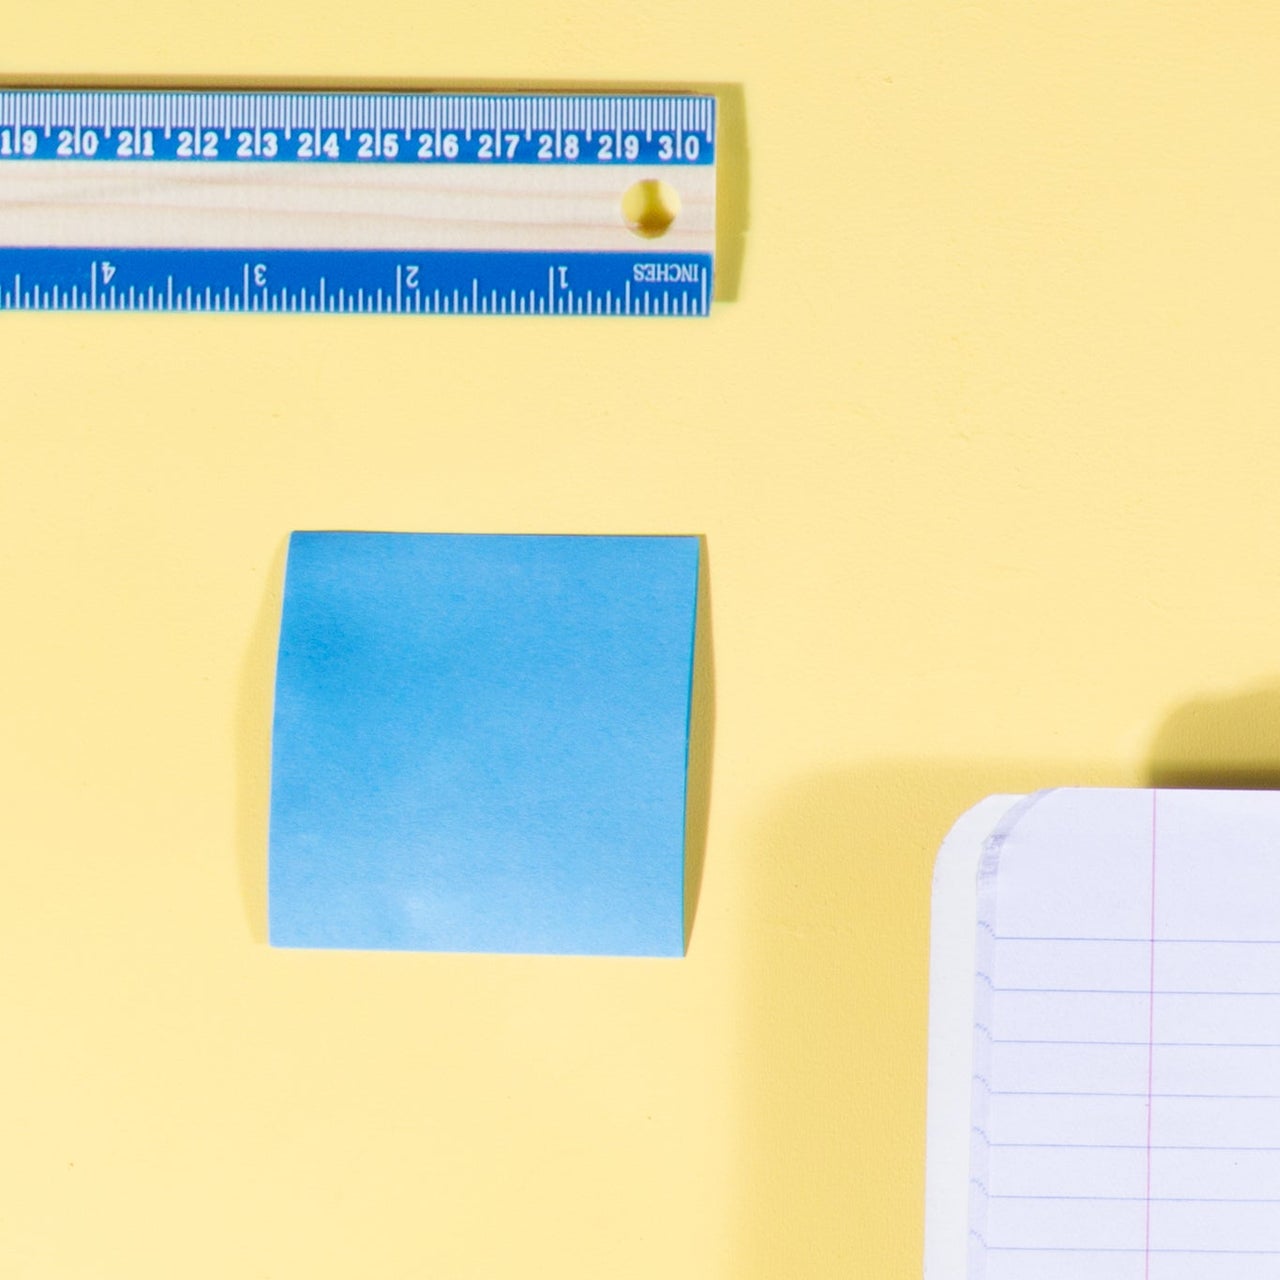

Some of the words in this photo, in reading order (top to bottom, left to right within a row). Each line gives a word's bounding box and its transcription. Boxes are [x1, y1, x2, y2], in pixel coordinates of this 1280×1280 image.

[0, 129, 38, 156] 19
[57, 130, 99, 157] 20
[117, 130, 154, 157] 21
[177, 131, 218, 157] 22
[236, 132, 279, 158] 23
[297, 132, 339, 159] 24
[358, 133, 399, 158] 25
[418, 133, 459, 159] 26
[478, 134, 520, 159] 27
[538, 134, 580, 159] 28
[598, 135, 639, 160] 29
[658, 135, 700, 161] 30
[101, 261, 116, 284] 4
[254, 263, 267, 286] 3
[406, 266, 419, 288] 2
[557, 266, 569, 289] 1
[633, 262, 699, 283] INCHES
